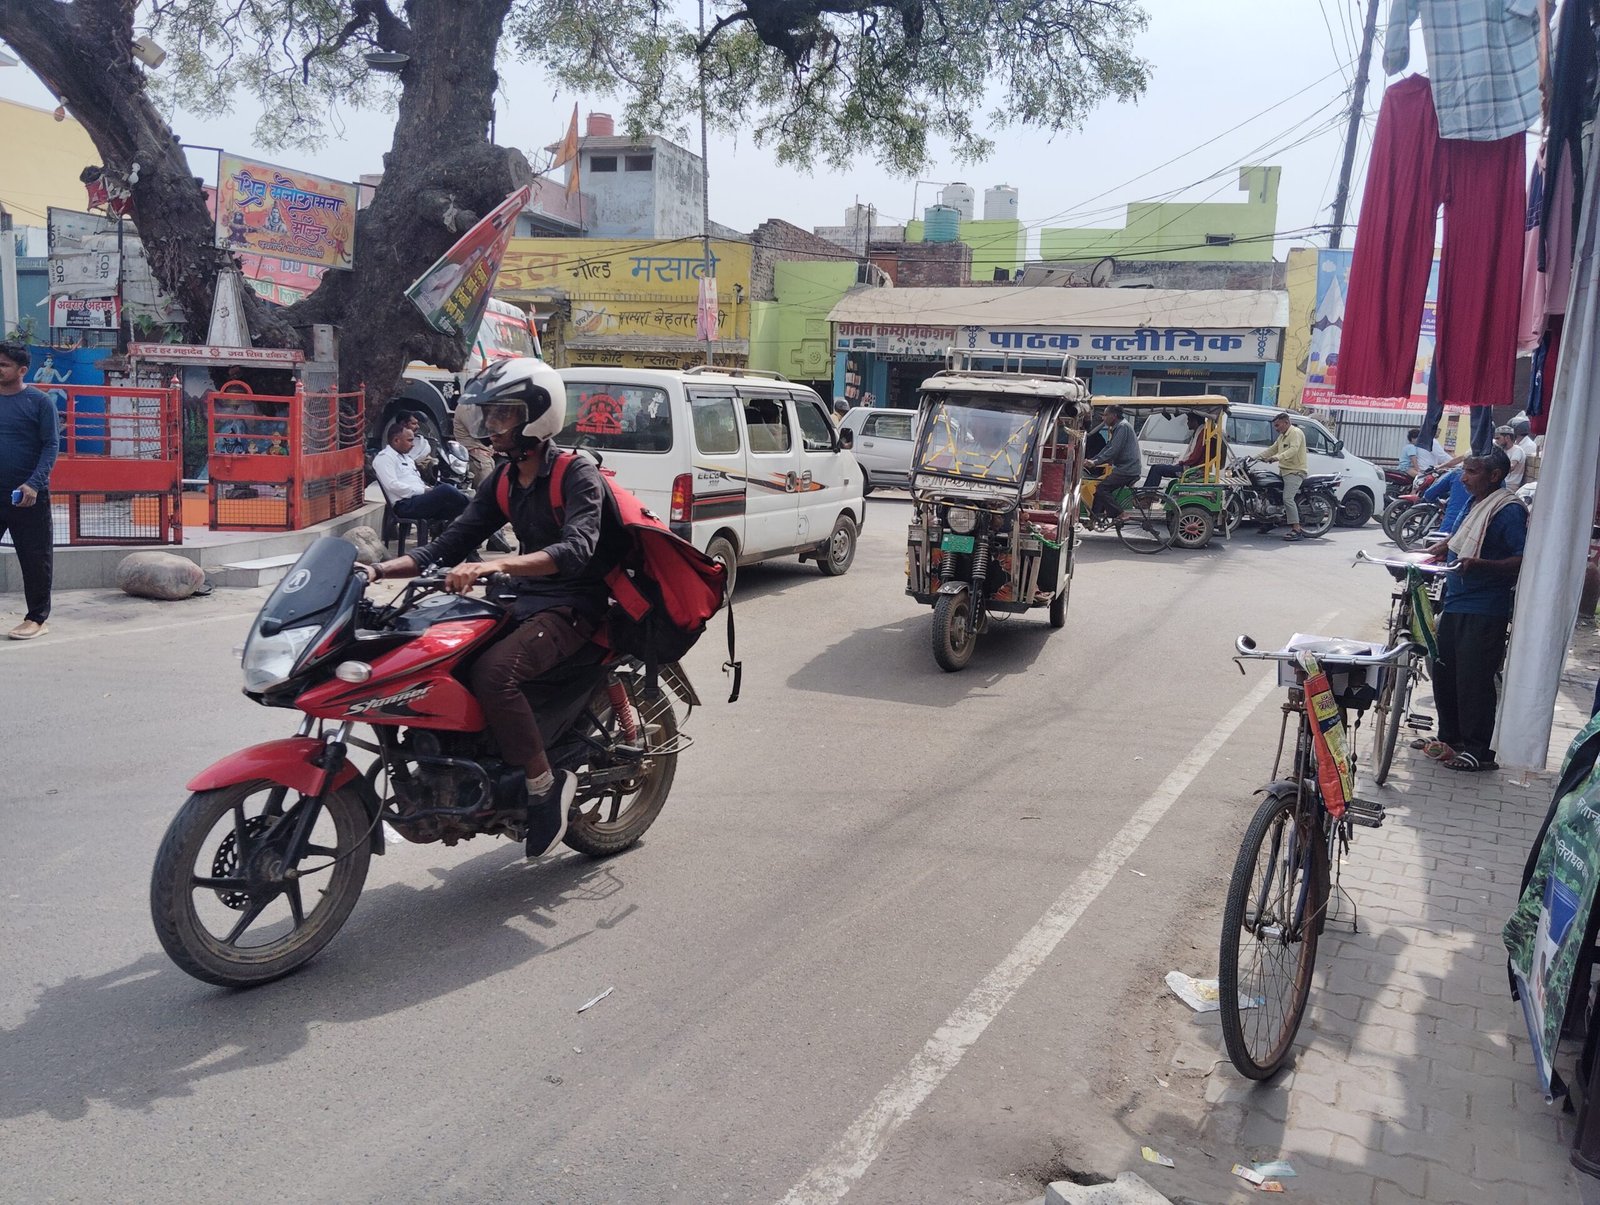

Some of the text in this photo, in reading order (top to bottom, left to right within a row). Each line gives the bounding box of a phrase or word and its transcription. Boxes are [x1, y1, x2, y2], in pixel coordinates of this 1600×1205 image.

[231, 169, 267, 207] शिव
[100, 254, 110, 279] COR
[566, 258, 612, 281] गोल्ड
[629, 250, 721, 283] मसाले
[173, 346, 203, 356] महादेव
[245, 349, 263, 358] शिव
[988, 328, 1246, 352] पाठक क्लीनिक
[575, 352, 595, 362] उच्च
[1111, 354, 1149, 362] पाठक
[342, 686, 432, 715] Stunner
